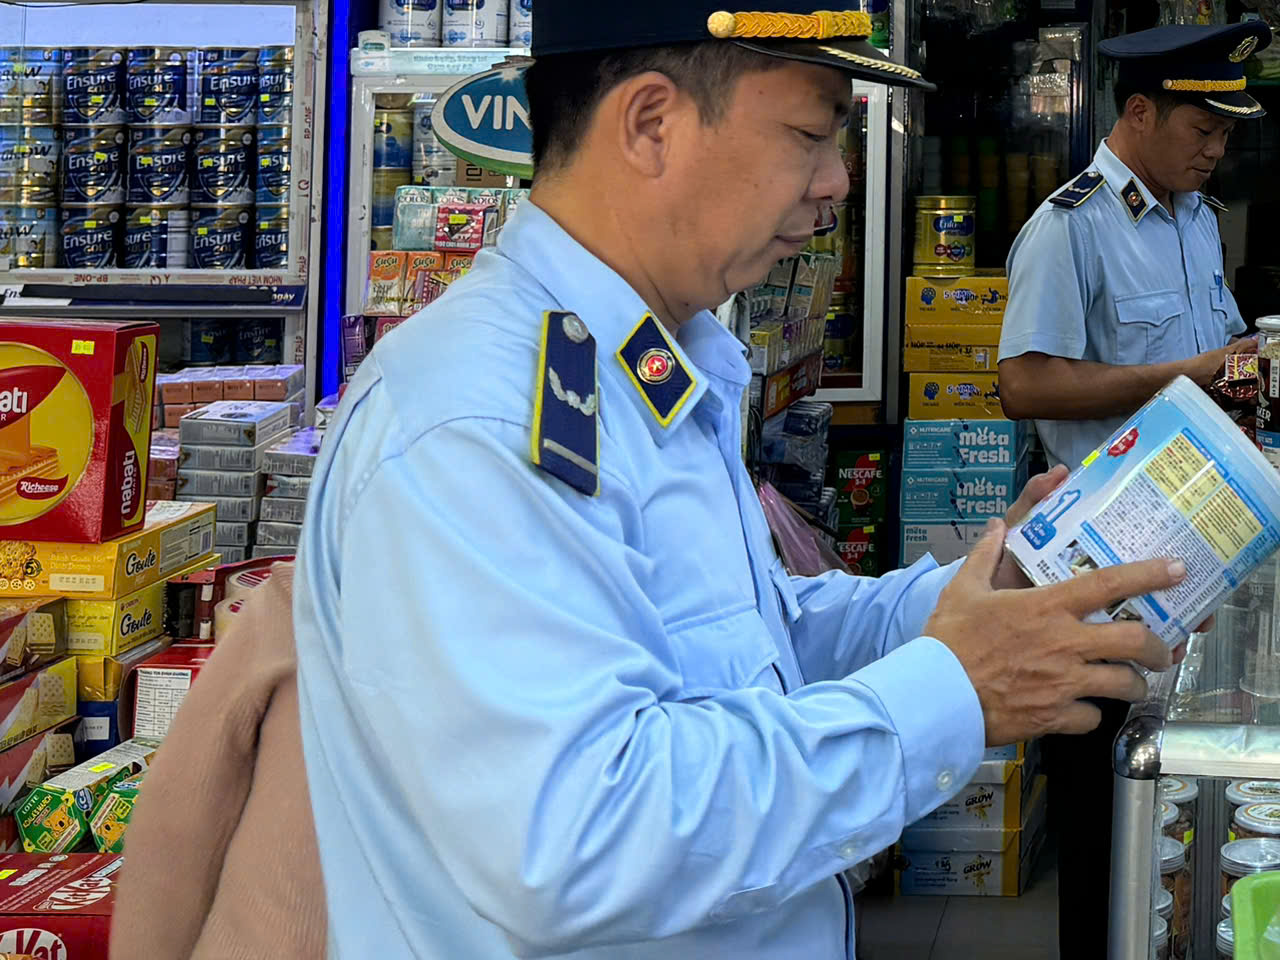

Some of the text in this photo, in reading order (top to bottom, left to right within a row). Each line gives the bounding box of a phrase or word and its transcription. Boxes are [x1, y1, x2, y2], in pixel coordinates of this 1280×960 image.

[66, 70, 116, 90] Ensure
[130, 70, 174, 90] Ensure
[462, 95, 533, 130] VIN
[64, 230, 113, 249] Ensure
[194, 231, 242, 249] Ensure
[74, 275, 109, 283] BP-ONE
[959, 447, 1010, 464] Fresh
[20, 481, 59, 493] Richeese
[121, 450, 135, 514] nabati
[956, 498, 1008, 515] Fresh
[21, 794, 40, 815] LOTTE
